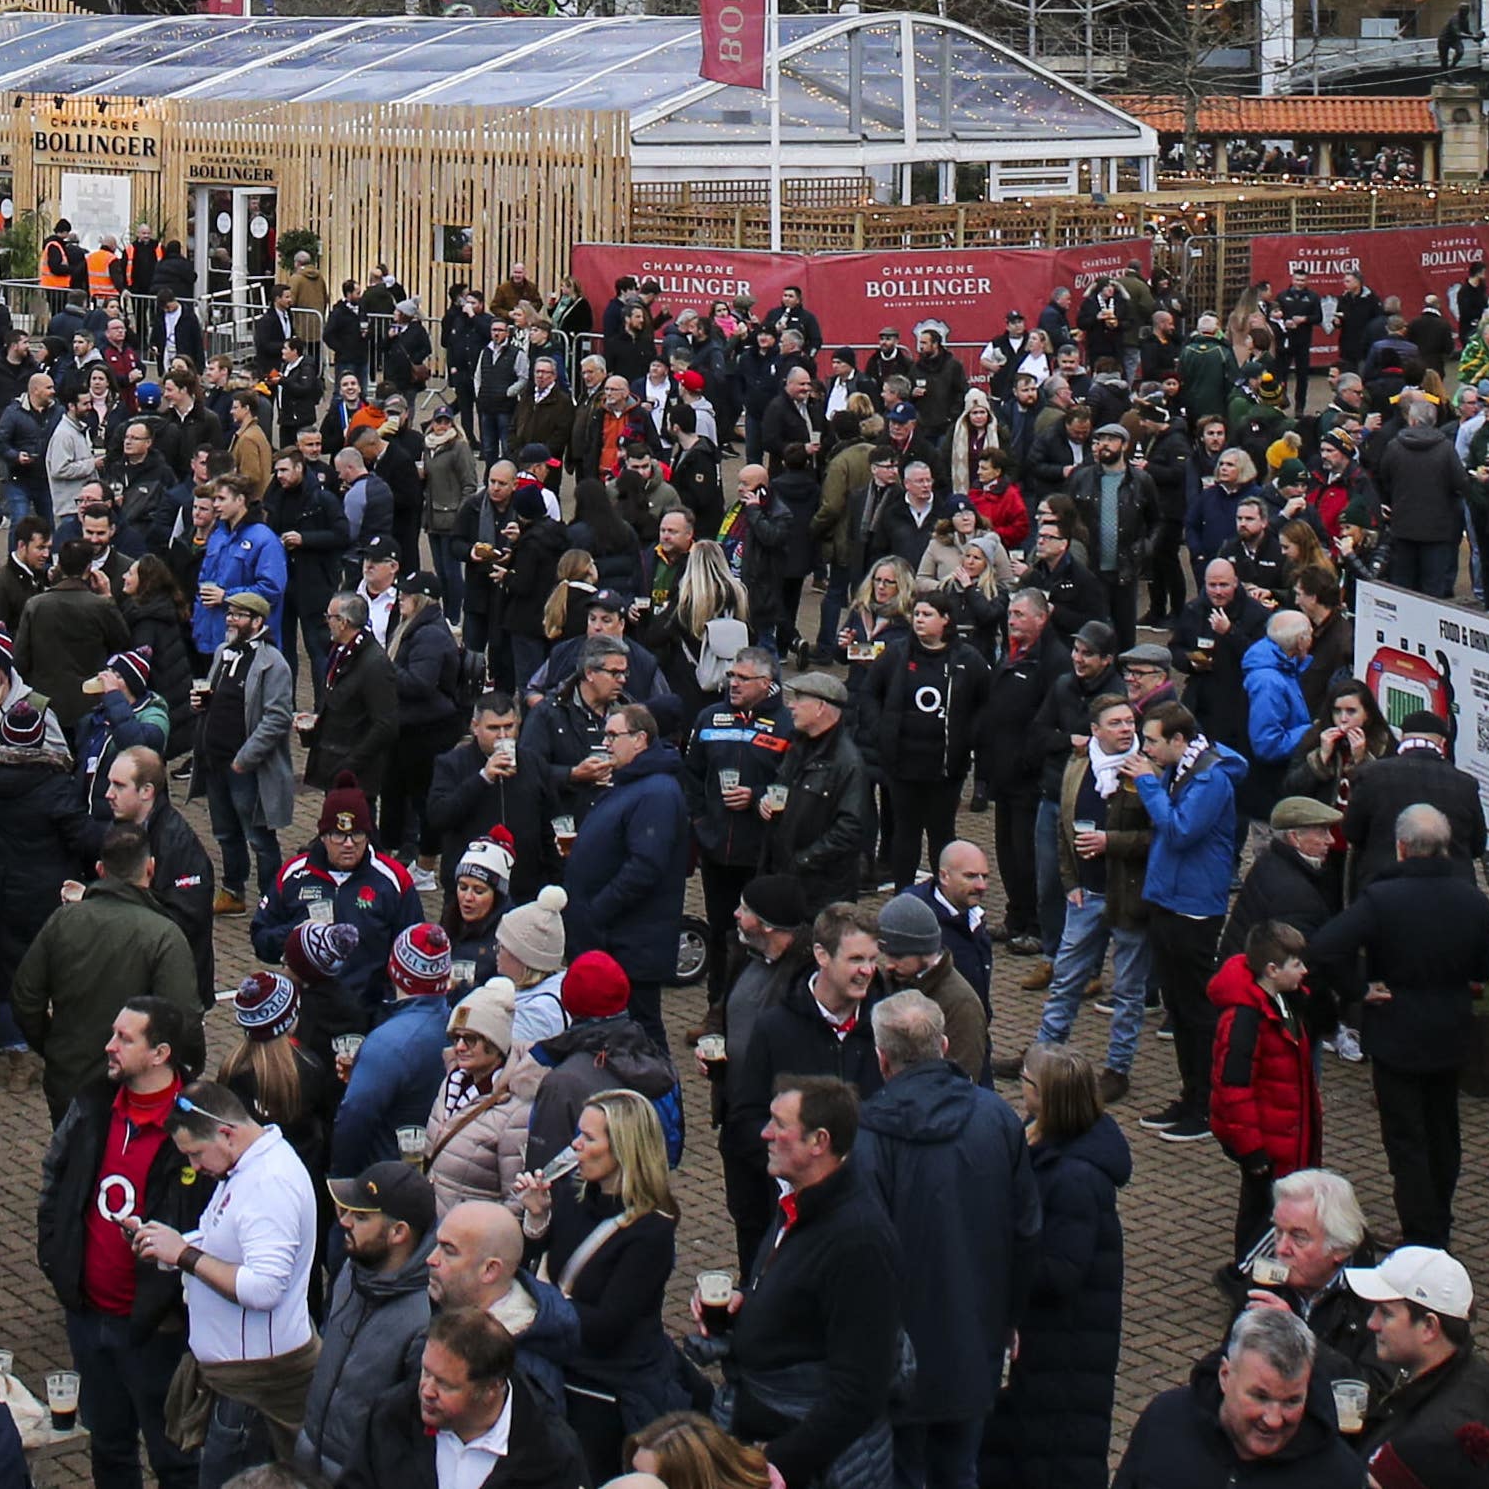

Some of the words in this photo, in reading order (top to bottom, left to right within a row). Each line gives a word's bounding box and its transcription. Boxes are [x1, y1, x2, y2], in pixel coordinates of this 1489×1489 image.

[51, 118, 140, 131] CHAMPAGNE
[35, 131, 157, 157] BOLLINGER
[189, 164, 273, 181] BOLLINGER
[642, 262, 734, 275] CHAMPAGNE
[882, 264, 974, 276] CHAMPAGNE
[866, 278, 991, 298] BOLLINGER
[1439, 618, 1460, 643] FOOD
[1462, 629, 1469, 646] &
